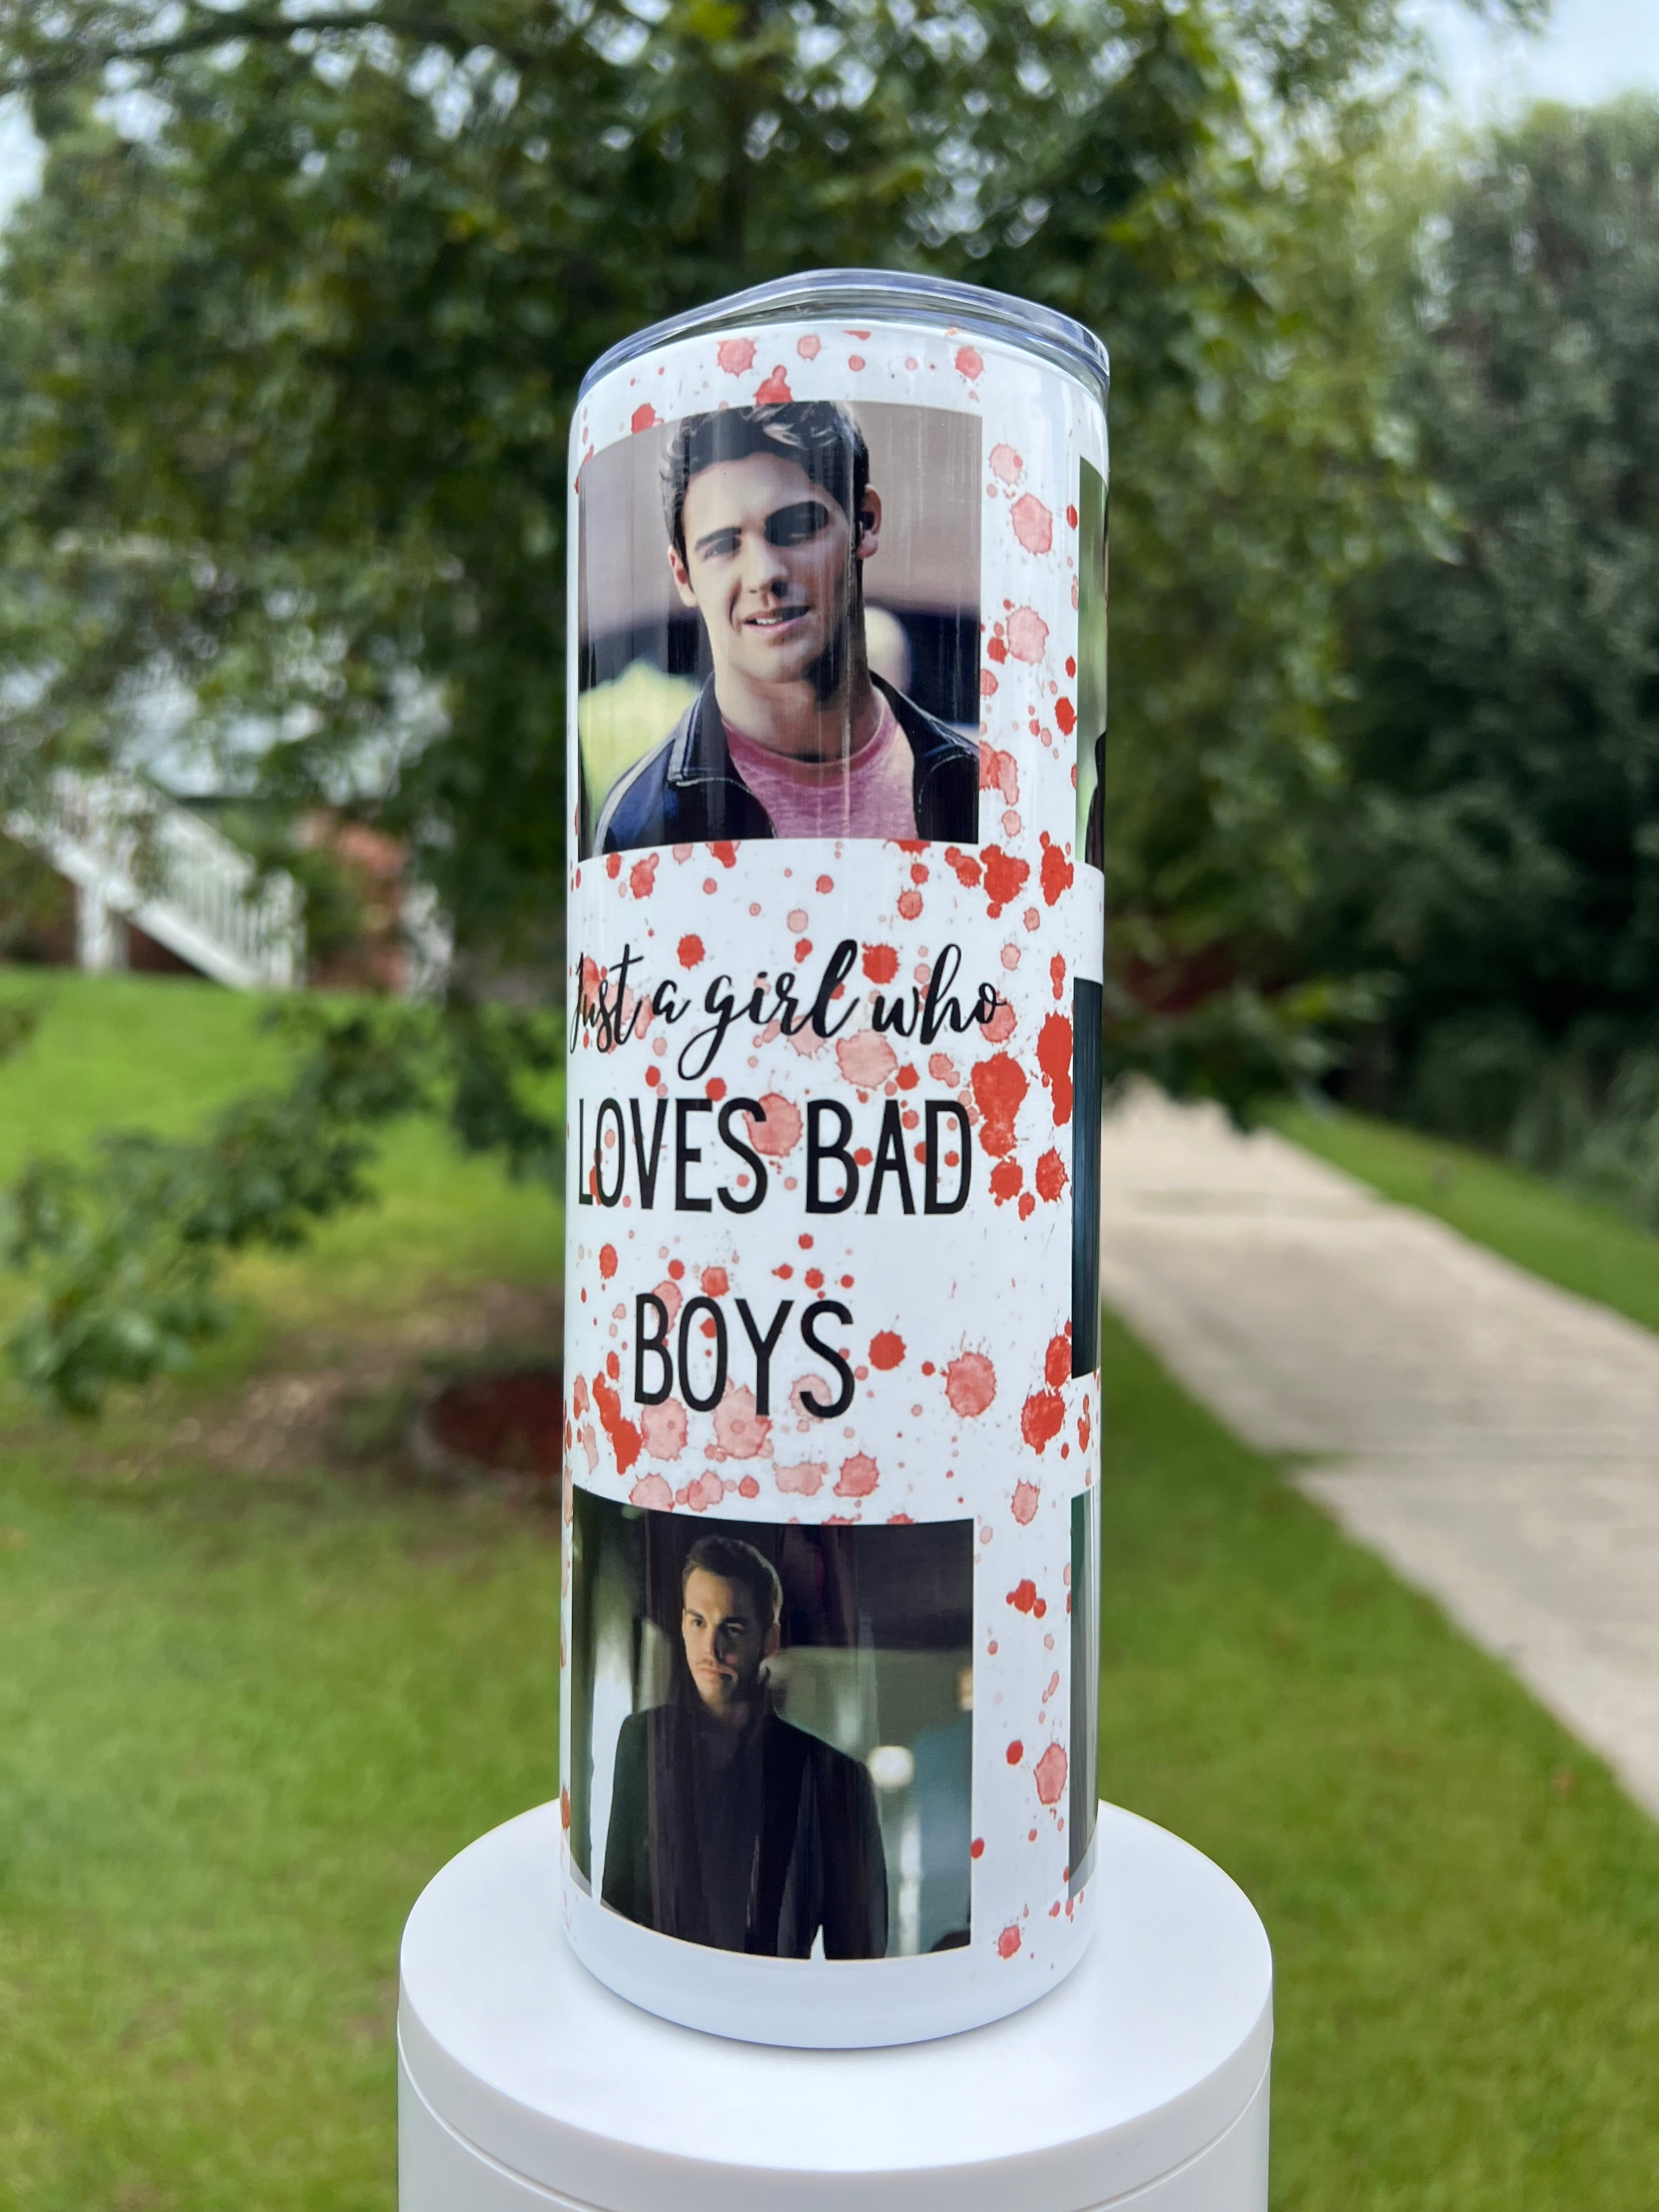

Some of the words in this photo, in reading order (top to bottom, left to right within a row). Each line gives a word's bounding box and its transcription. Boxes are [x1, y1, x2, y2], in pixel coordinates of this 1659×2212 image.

[570, 943, 645, 1054] Just
[652, 980, 692, 1024] a
[678, 939, 860, 1081] girl
[872, 944, 1007, 1045] who
[578, 1098, 768, 1214] LOVES
[805, 1100, 973, 1215] BAD
[634, 1293, 855, 1419] BOYS
